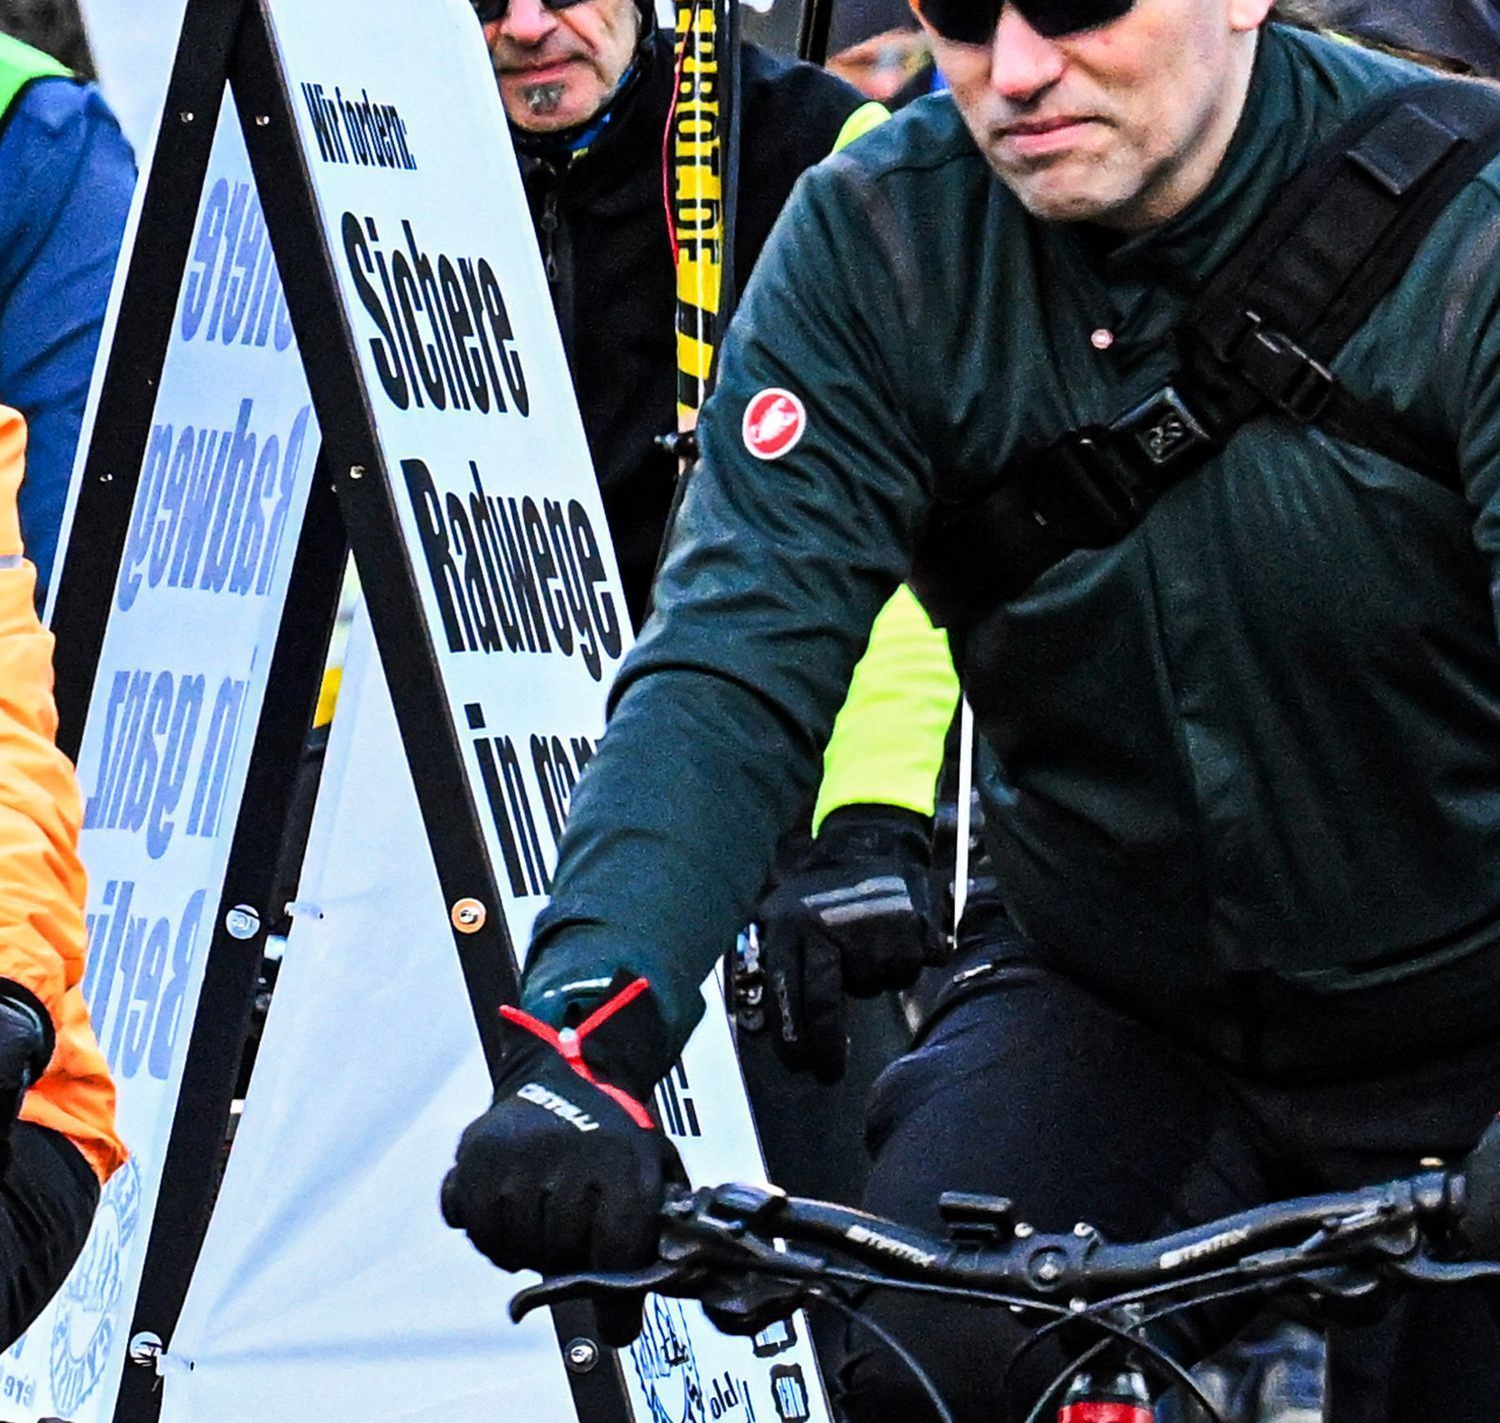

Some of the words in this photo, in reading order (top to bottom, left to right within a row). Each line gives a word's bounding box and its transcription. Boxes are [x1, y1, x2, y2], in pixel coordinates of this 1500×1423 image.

[300, 82, 348, 165] Wir
[343, 89, 417, 171] fordern:
[341, 211, 530, 418] Sichere
[401, 460, 623, 682] Radwege
[464, 702, 547, 897] in
